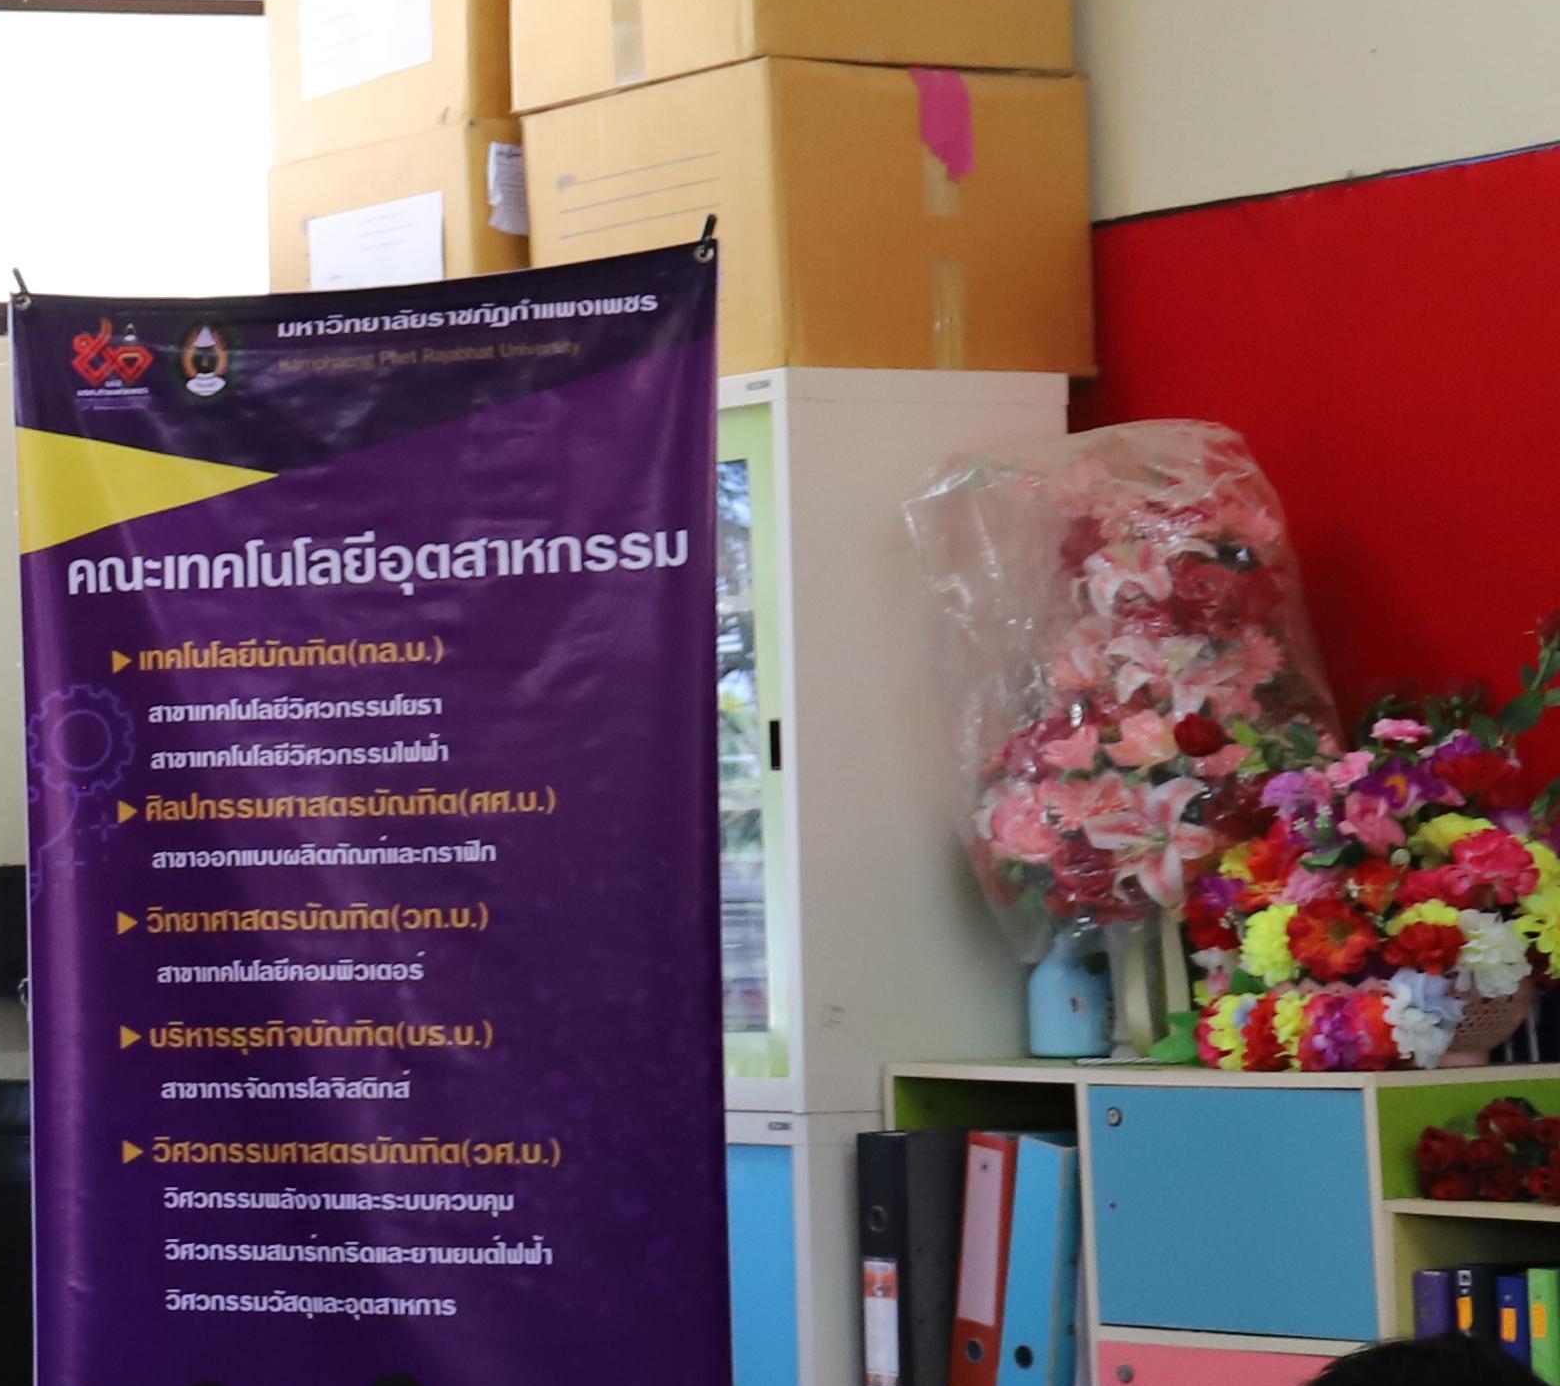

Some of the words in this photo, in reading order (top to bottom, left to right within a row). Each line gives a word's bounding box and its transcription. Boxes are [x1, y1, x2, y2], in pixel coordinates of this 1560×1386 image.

[277, 292, 659, 339] มหาวิทยาลัยราชภัฏกำแพงเพชร
[67, 529, 689, 596] คณะเทคโนโลยีอุตสาหกรรม
[138, 636, 445, 671] เทคโนโลยีบัณฑิต(ทล.บ.)
[148, 693, 443, 725] สาขาเทคโนโลยีวิศวกรรมโยธา
[150, 732, 449, 771] สาขาเทคโนโลยีวิศวกรรมไฟฟ้า
[145, 786, 557, 823] ศิลปกรรมศาสตรบัณฑิต(ศศ.บ.)
[151, 836, 497, 870] สาขาออกแบบผลิตภัณฑ์และกราฟิก
[146, 902, 490, 932] วิทยาศาสตรบัณฑิต(วท.บ.)
[157, 952, 425, 985] สาขาเทคโนโลยีคอมพิวเตอร์
[149, 1018, 494, 1054] บริหารธุรกิจบัณฑิต(บธ.บ.)
[160, 1070, 411, 1101] สาขาการจัดการโลจิสติกส์
[153, 1136, 562, 1167] วิศวกรรมศาสตรบัณฑิต(วศ.บ.)
[162, 1186, 516, 1218] วิศวกรรมพลังงานและระบบควบคุม
[163, 1232, 554, 1266] วิศวกรรมสมาร์ทกริดและยานยนต์ไฟฟ้า
[165, 1290, 458, 1320] วิศวกรรมวัสดุและอุตสาหการ
